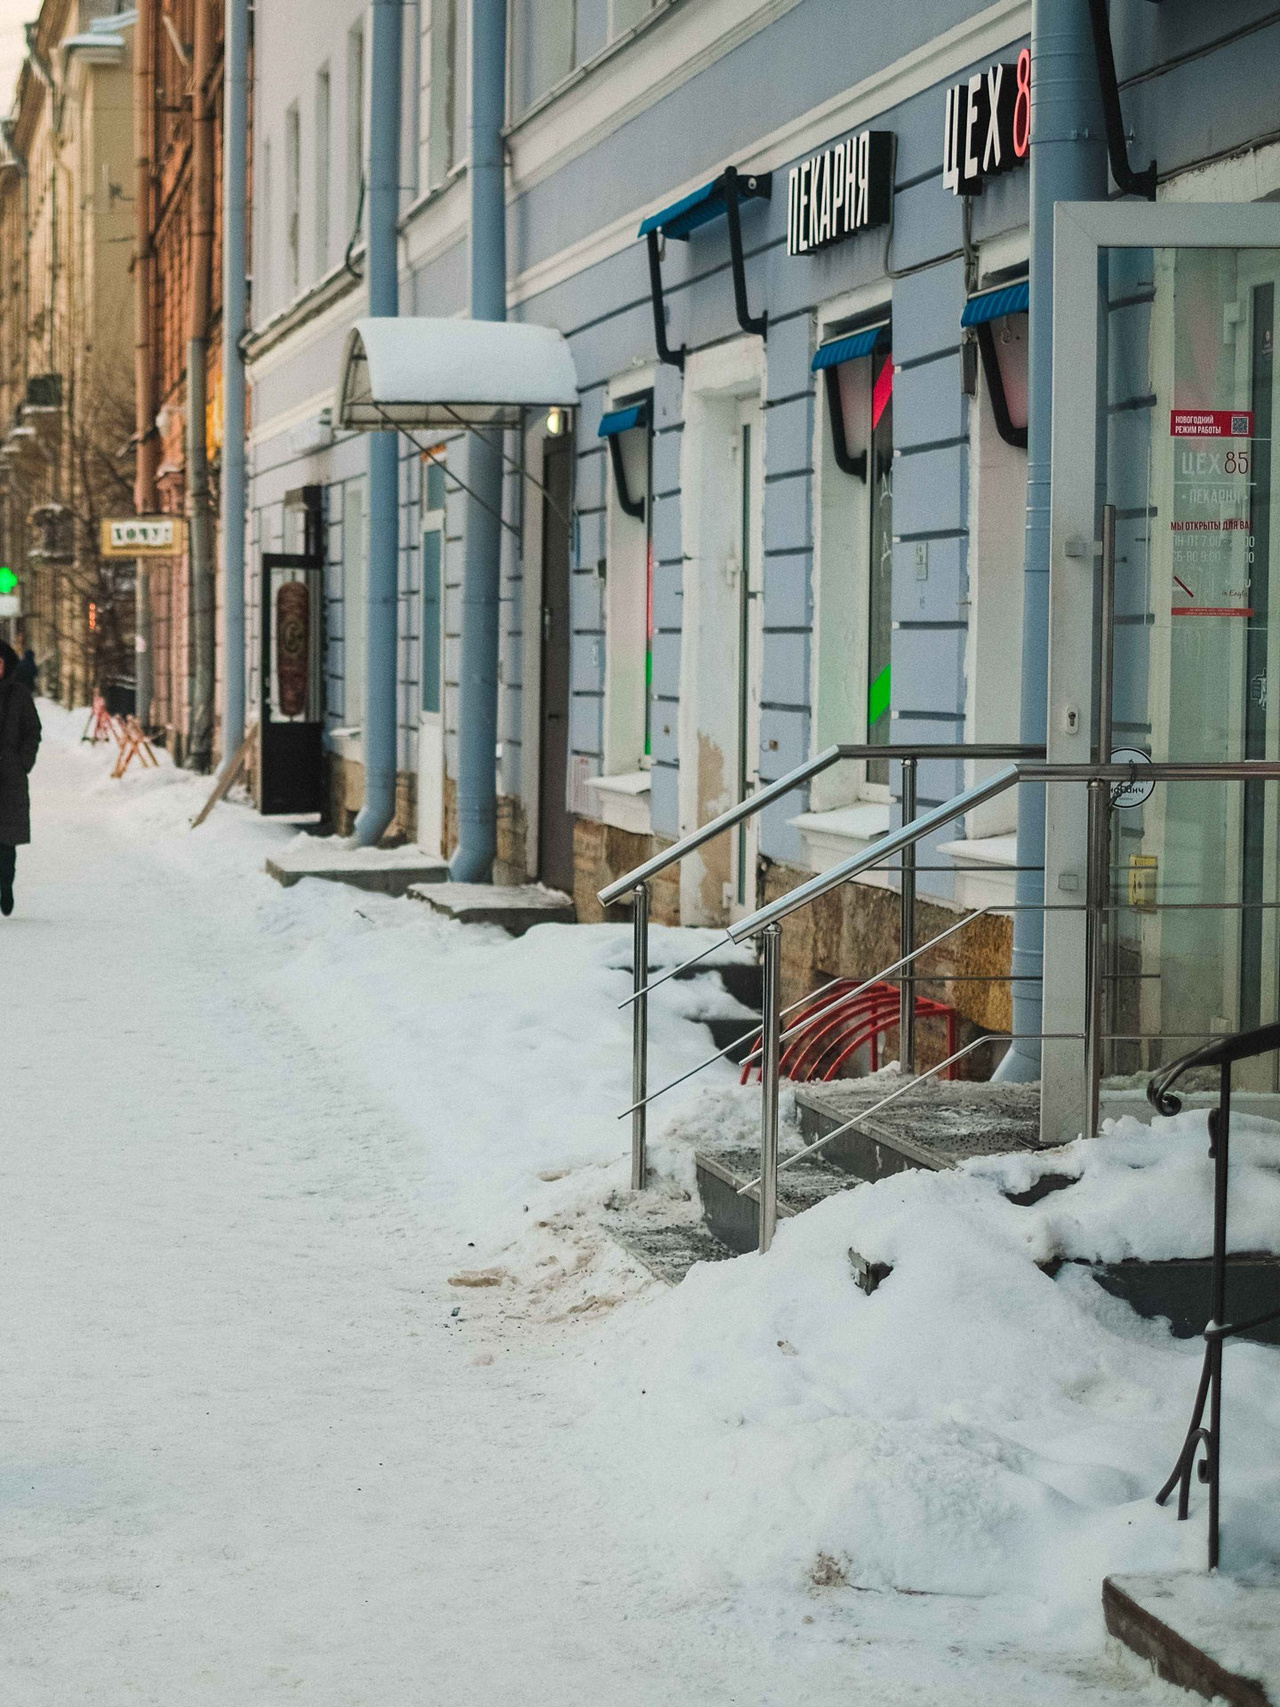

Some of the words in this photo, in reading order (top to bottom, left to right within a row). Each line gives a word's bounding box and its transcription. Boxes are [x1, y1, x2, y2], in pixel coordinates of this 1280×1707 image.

[943, 63, 1003, 195] ЦЕХ
[787, 130, 870, 256] ПЕКАРНЯ
[1175, 415, 1214, 424] НОВОГОДНИЙ
[1175, 426, 1197, 434] РЕЖИМ
[1197, 426, 1222, 434] РАБОТЫ
[1181, 451, 1221, 476] ЦЕХ
[1224, 451, 1249, 474] 85
[1170, 521, 1183, 531] МЫ
[1185, 521, 1221, 531] ОТКРЫТЫ
[1222, 521, 1238, 531] ДЛЯ
